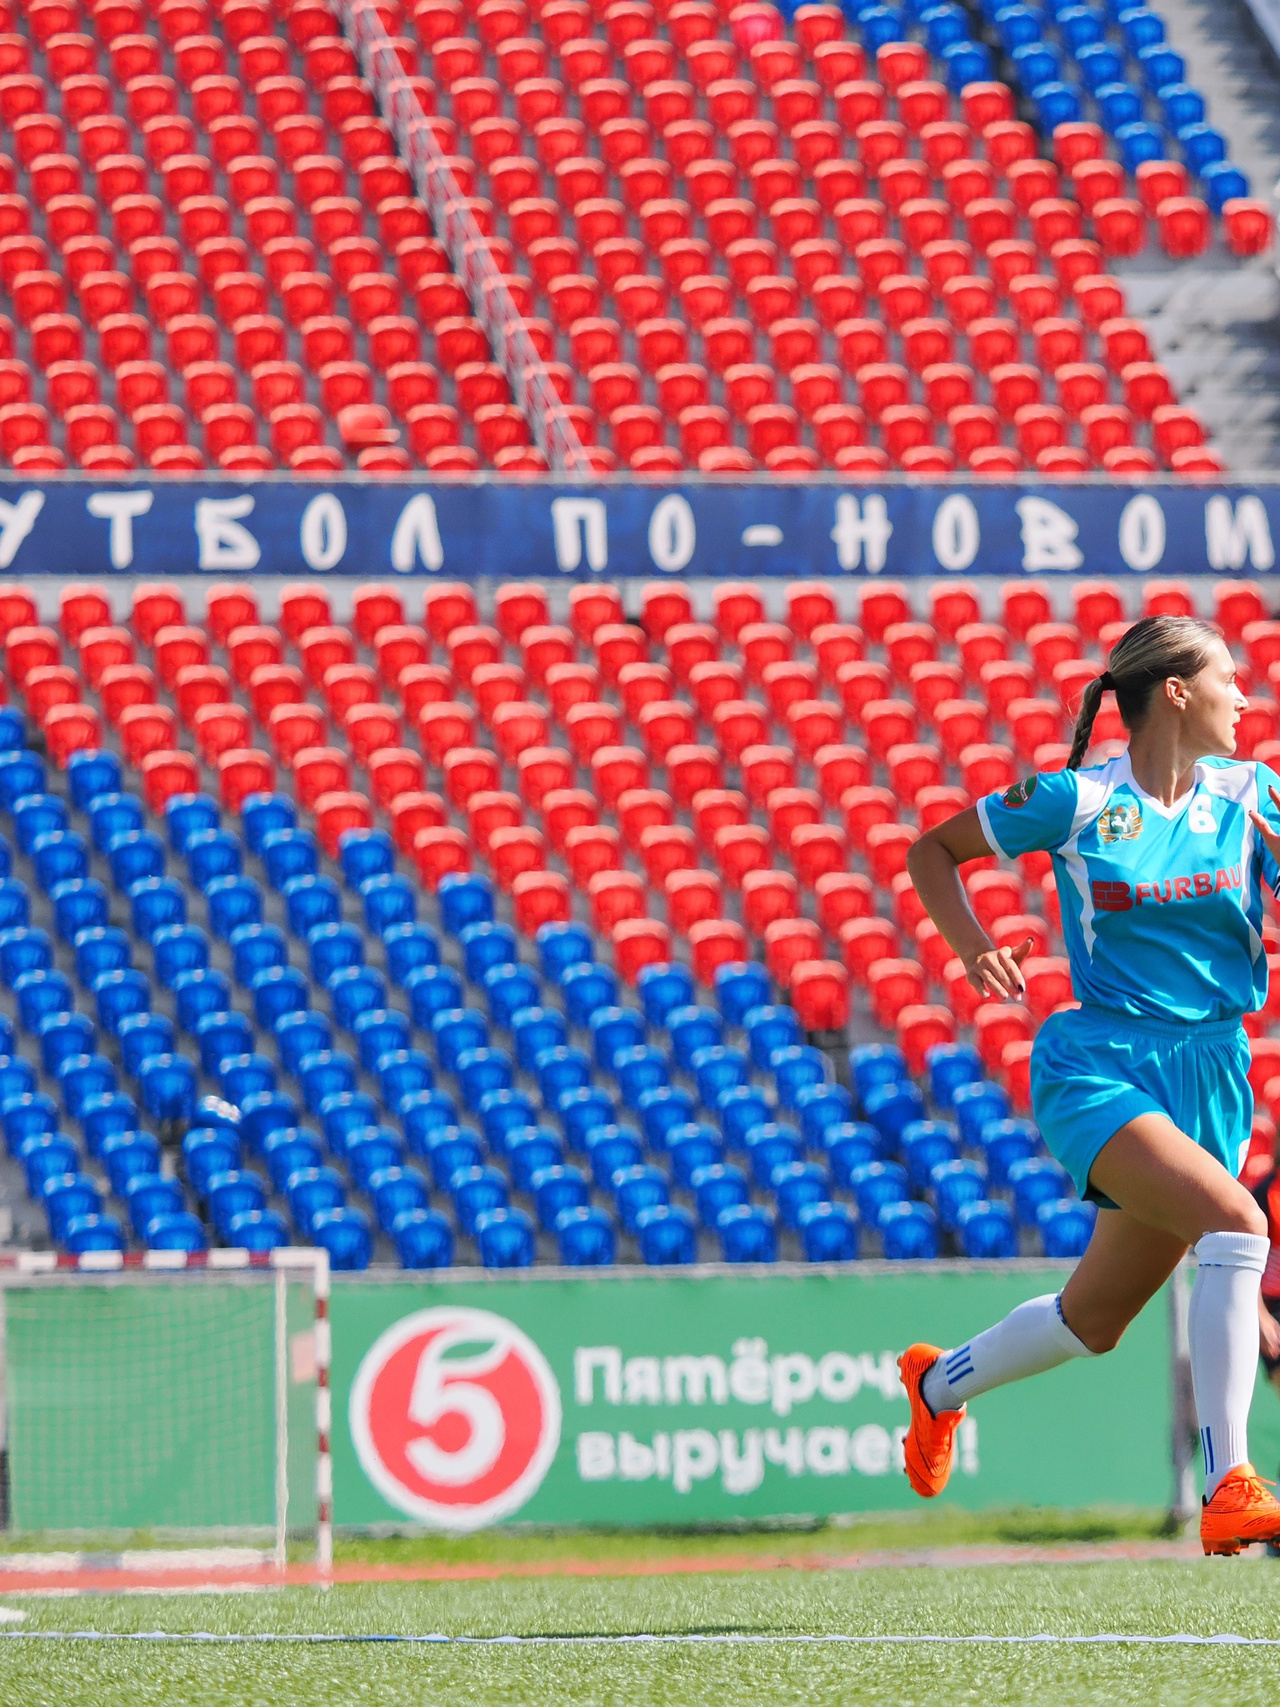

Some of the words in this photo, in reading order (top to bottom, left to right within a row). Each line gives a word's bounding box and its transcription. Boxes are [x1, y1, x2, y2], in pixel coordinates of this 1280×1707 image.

[1187, 793, 1218, 834] 6
[1135, 863, 1242, 906] FURBAU
[404, 1322, 512, 1487] 5
[574, 1336, 908, 1415] Пятёроч
